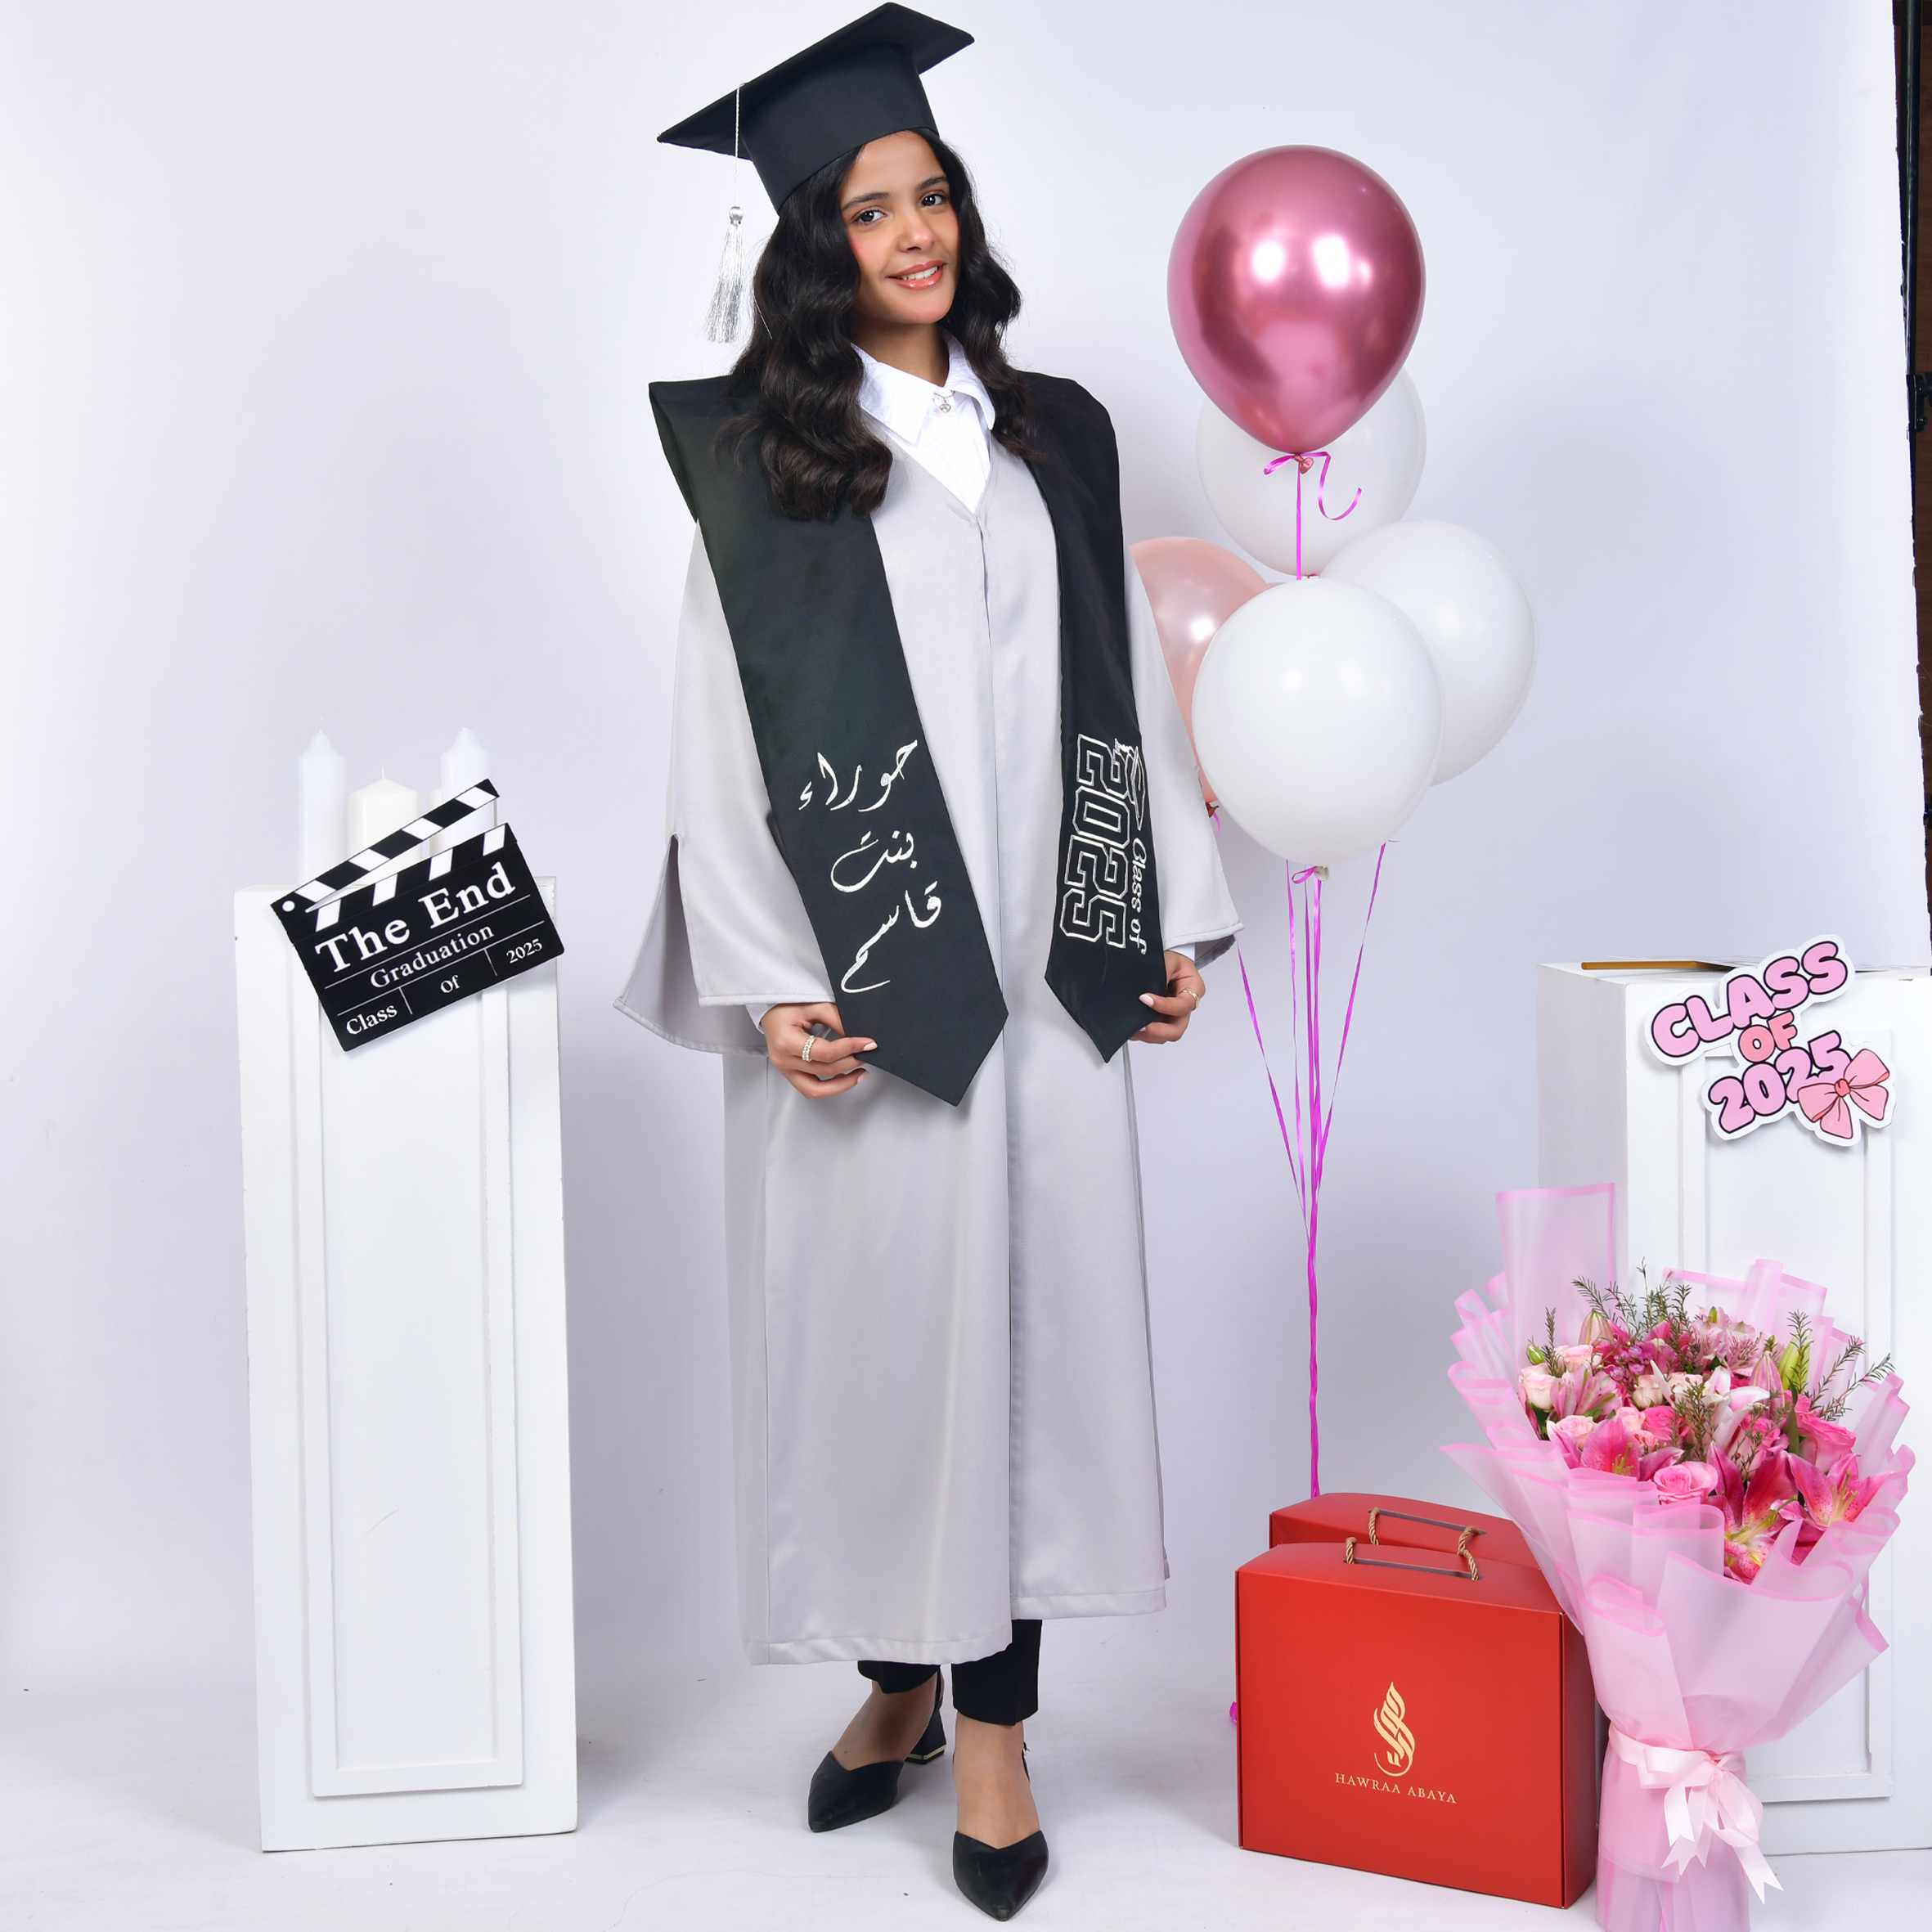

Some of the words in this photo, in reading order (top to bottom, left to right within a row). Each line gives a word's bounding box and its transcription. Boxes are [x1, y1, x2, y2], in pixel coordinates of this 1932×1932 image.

[798, 739, 918, 812] حوراء
[830, 830, 918, 893] بنت
[1059, 733, 1130, 950] 2025
[1131, 837, 1147, 914] Class
[315, 917, 410, 973] The
[417, 861, 515, 929] End
[841, 880, 941, 994] قاسم
[1129, 918, 1147, 955] of
[346, 1004, 398, 1035] Class
[506, 938, 542, 964] 2025
[370, 925, 494, 988] Graduation
[1651, 940, 1848, 1058] CLASS
[1738, 1010, 1798, 1063] OF
[1708, 1029, 1853, 1134] 2025
[1335, 1772, 1401, 1794] HAWRAA
[1408, 1786, 1457, 1804] ABAYA
